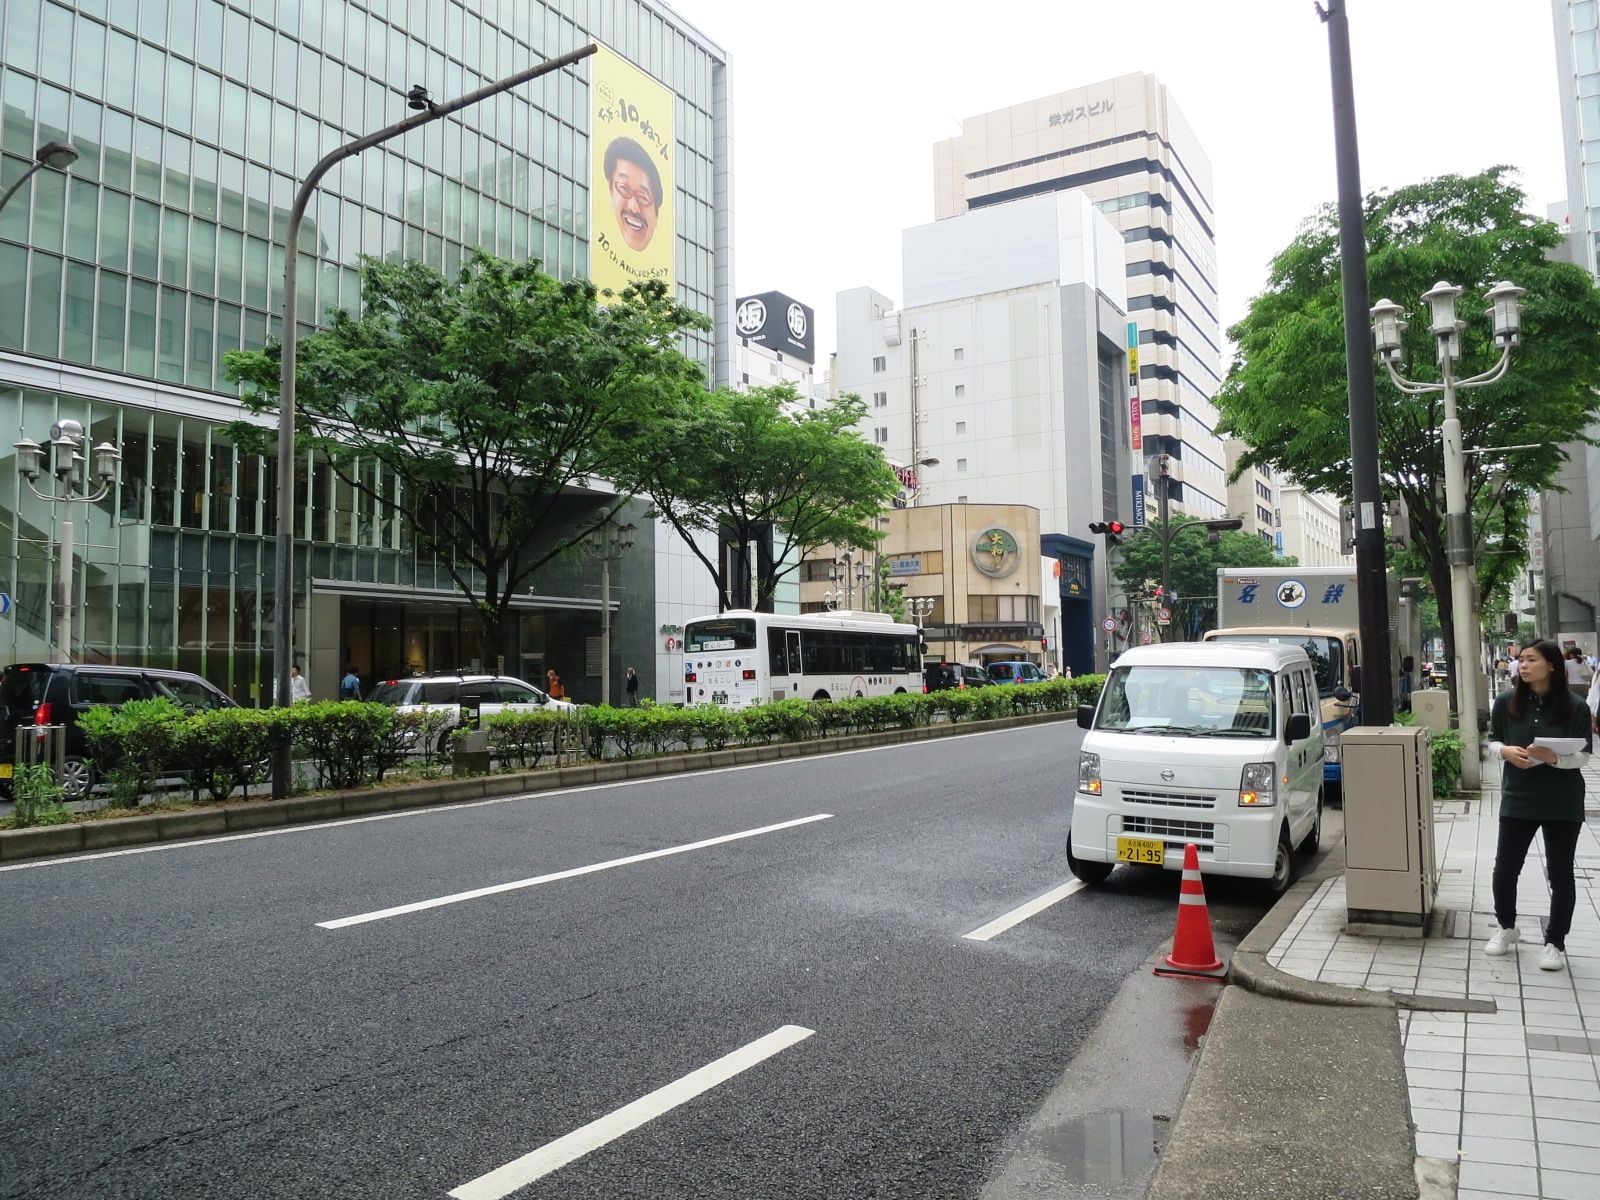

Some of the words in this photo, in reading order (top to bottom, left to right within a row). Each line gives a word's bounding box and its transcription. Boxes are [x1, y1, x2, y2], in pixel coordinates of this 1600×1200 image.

[1048, 98, 1114, 127] 栄ガスビル
[1126, 848, 1161, 862] 21-95
